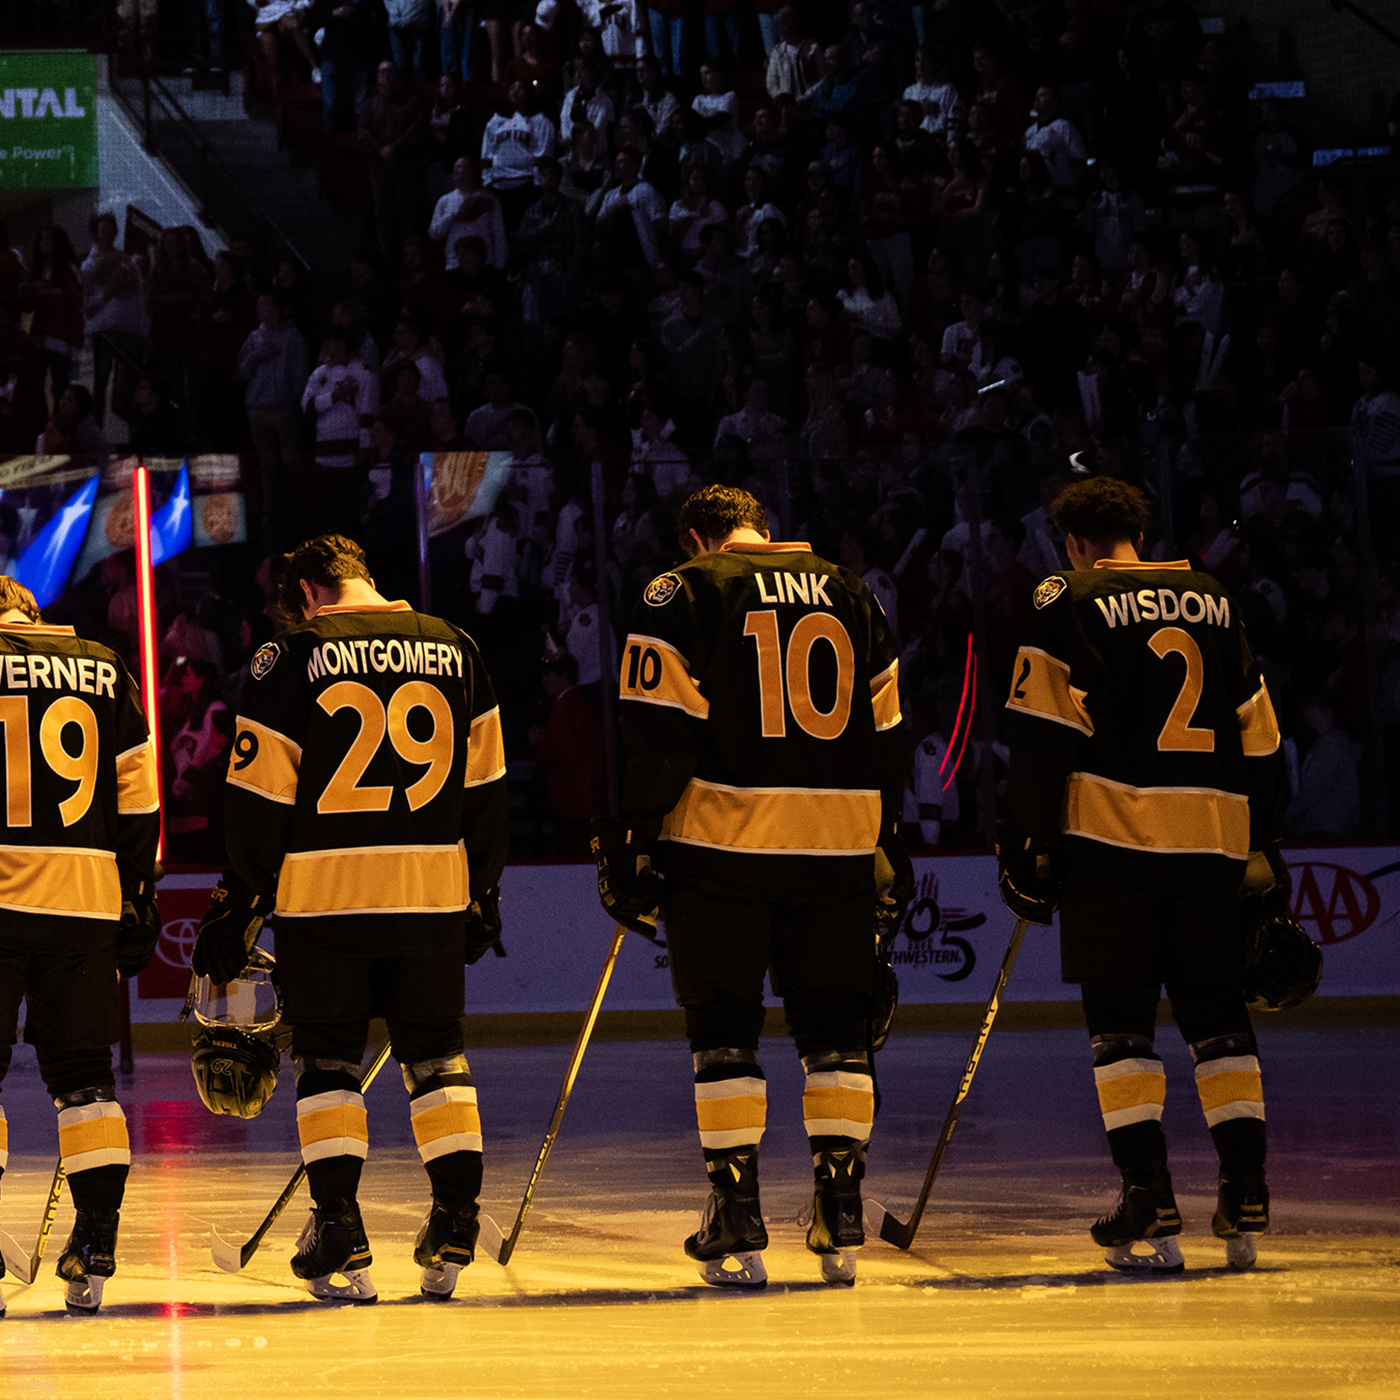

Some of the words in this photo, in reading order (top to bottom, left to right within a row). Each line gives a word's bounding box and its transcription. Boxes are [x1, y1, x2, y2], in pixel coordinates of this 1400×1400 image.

[754, 570, 834, 608] LINK
[1093, 588, 1231, 630] WISDOM
[306, 639, 463, 683] MONTGOMERY
[628, 646, 662, 691] 10
[742, 609, 856, 742] 10
[1014, 658, 1031, 699] 2
[1146, 626, 1215, 753] 2
[234, 731, 258, 771] 9
[315, 680, 455, 815] 29
[1285, 863, 1366, 942] AA
[210, 1058, 234, 1077] 29
